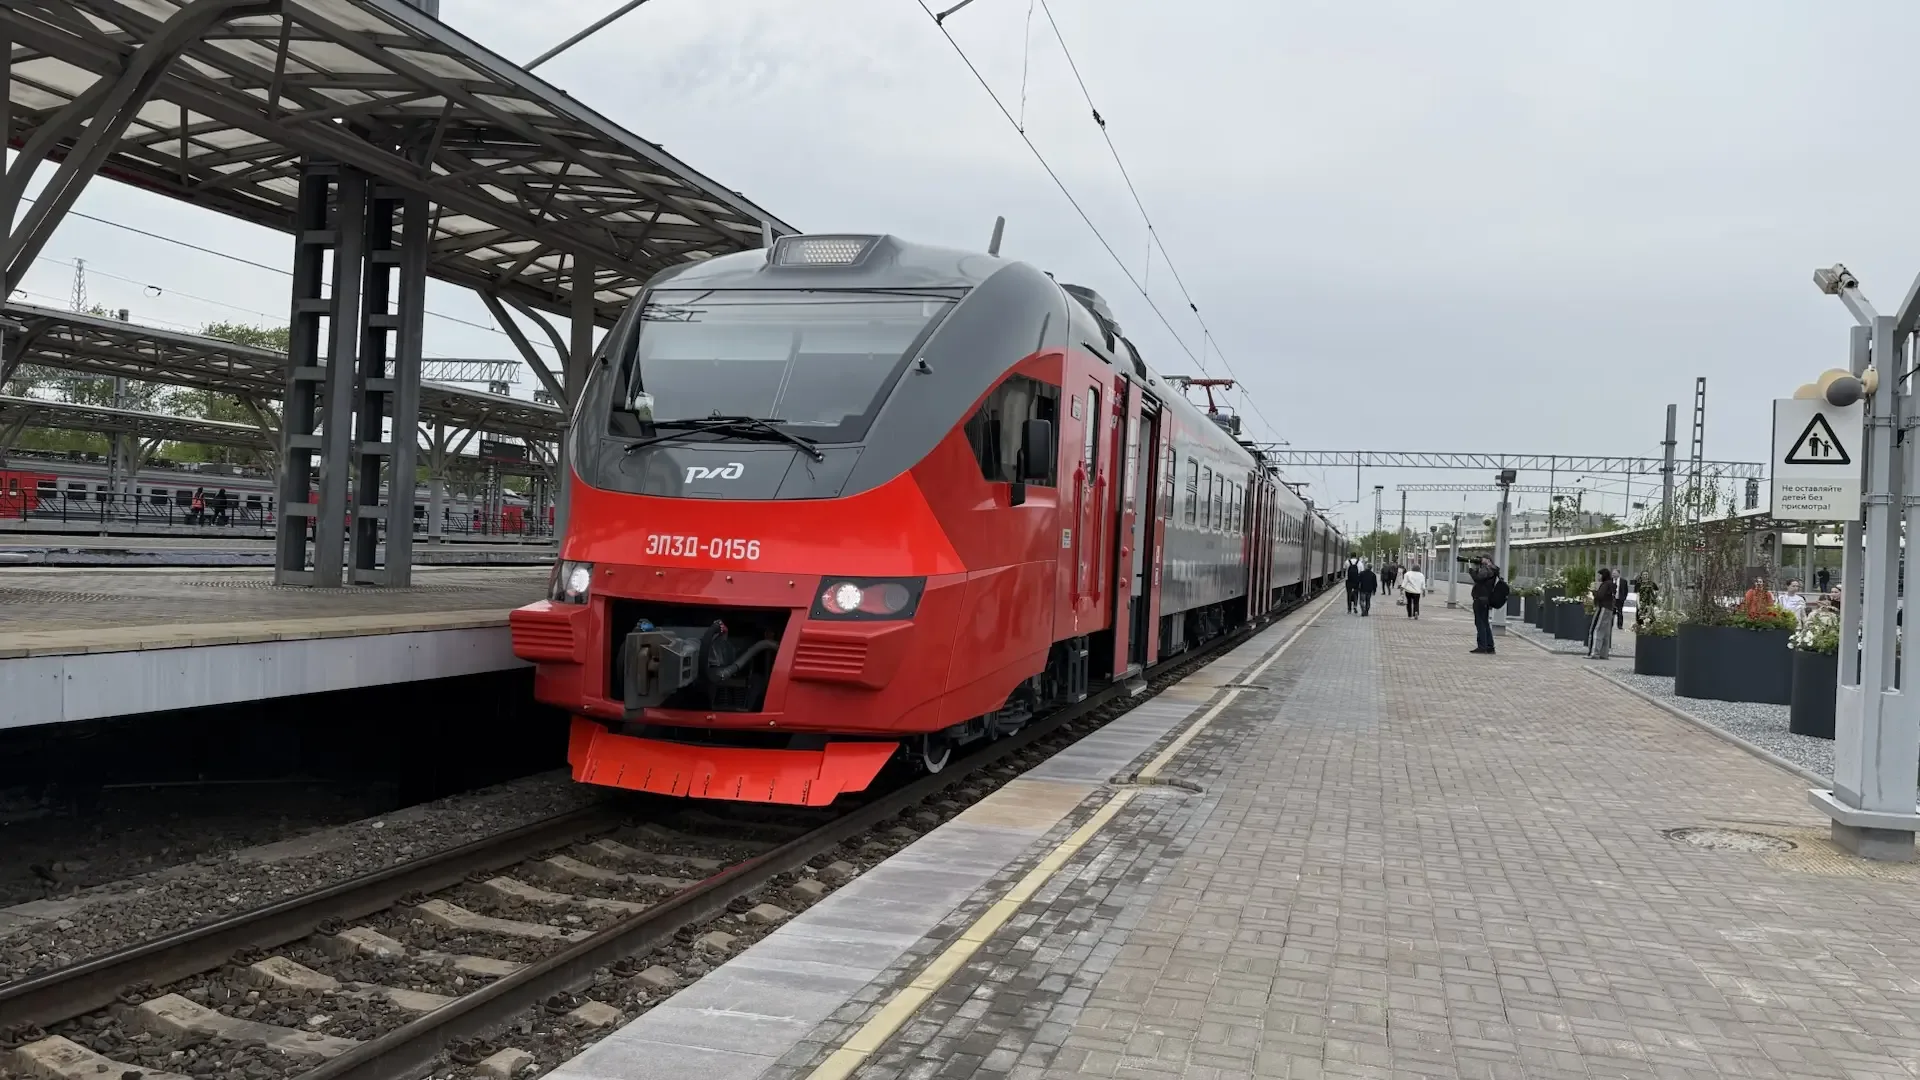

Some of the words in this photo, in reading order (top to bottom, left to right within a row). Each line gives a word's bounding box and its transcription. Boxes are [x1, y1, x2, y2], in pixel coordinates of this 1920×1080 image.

[1782, 484, 1793, 492] Не
[1794, 484, 1843, 492] оставляйте
[1781, 493, 1807, 501] детей
[1808, 493, 1823, 501] без
[1781, 503, 1831, 511] присмотра!
